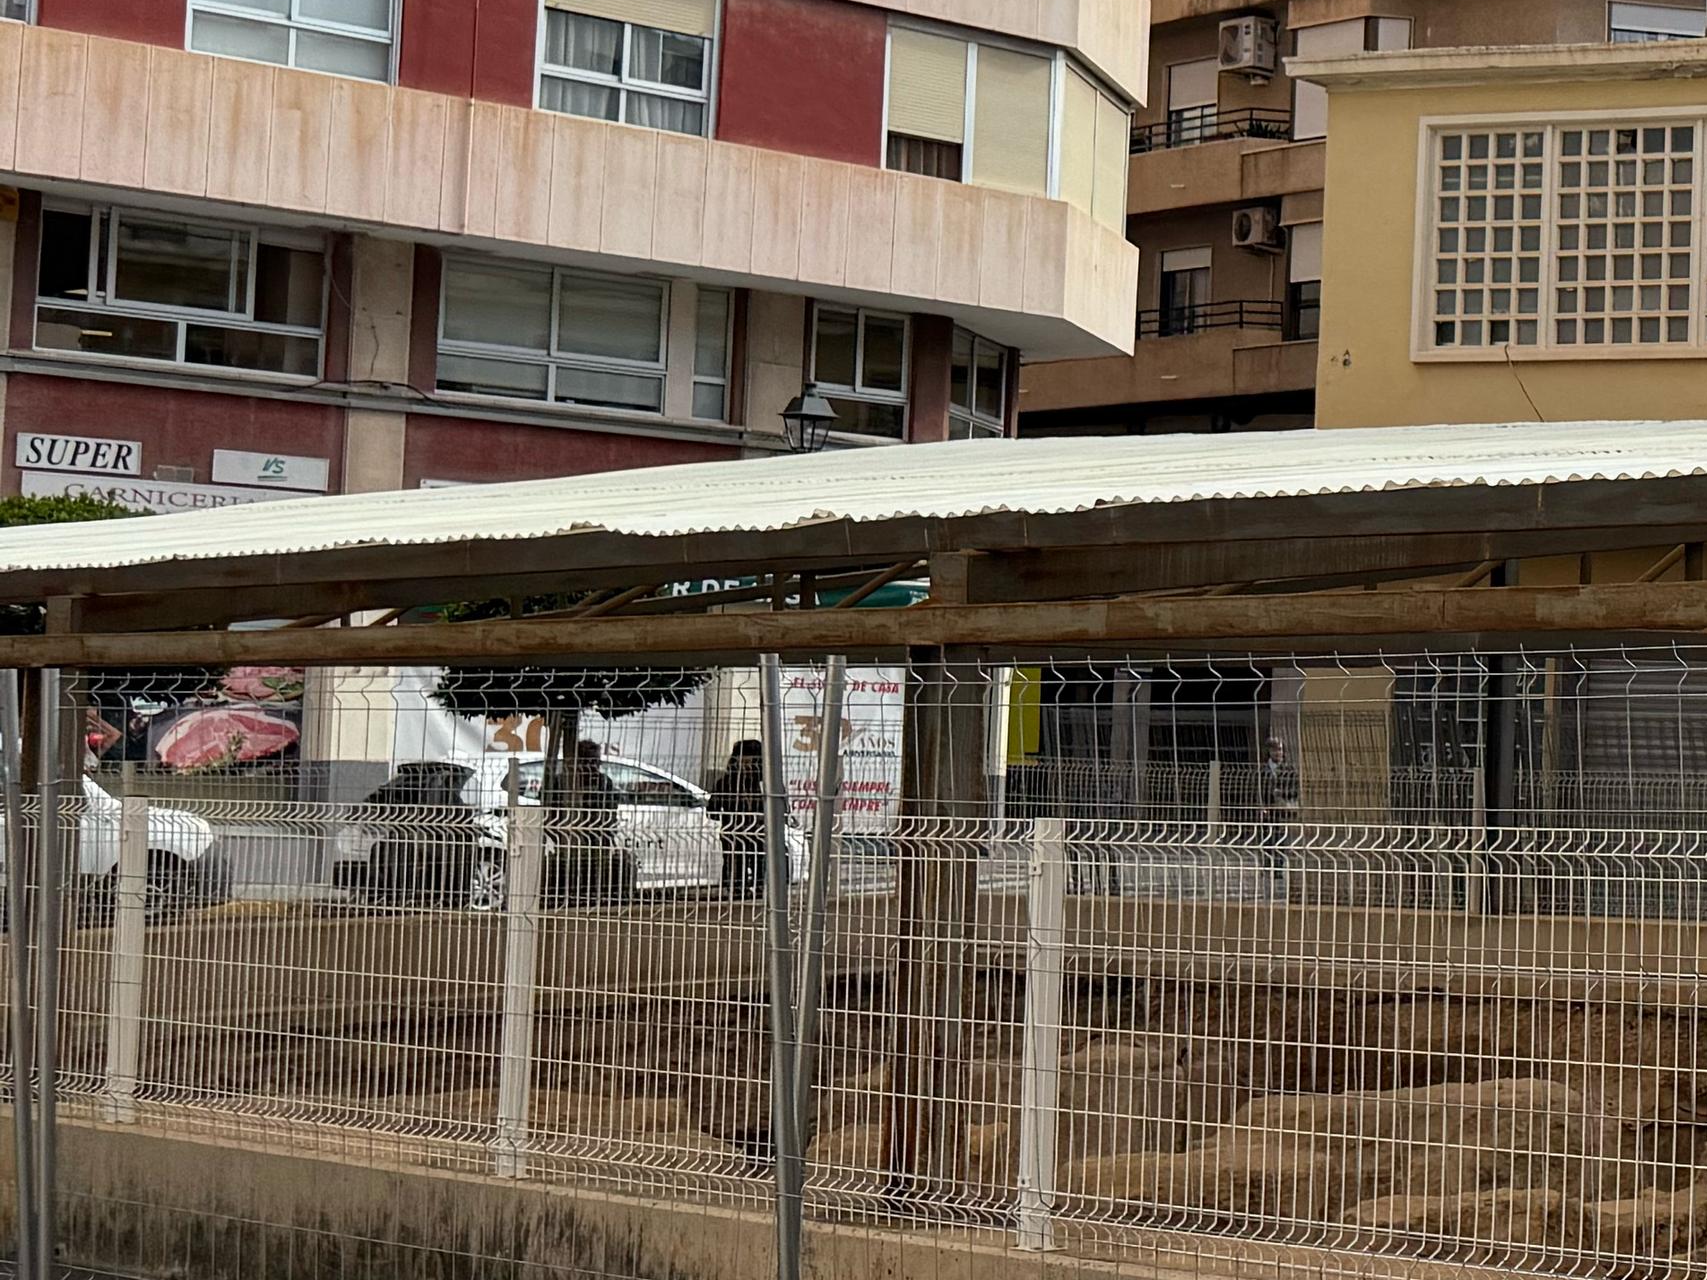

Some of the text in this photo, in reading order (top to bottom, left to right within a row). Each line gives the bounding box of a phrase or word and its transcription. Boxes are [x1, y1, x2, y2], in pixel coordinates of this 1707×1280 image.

[25, 436, 133, 471] SUPER
[64, 483, 256, 509] CARNICERI
[871, 682, 899, 694] CASA
